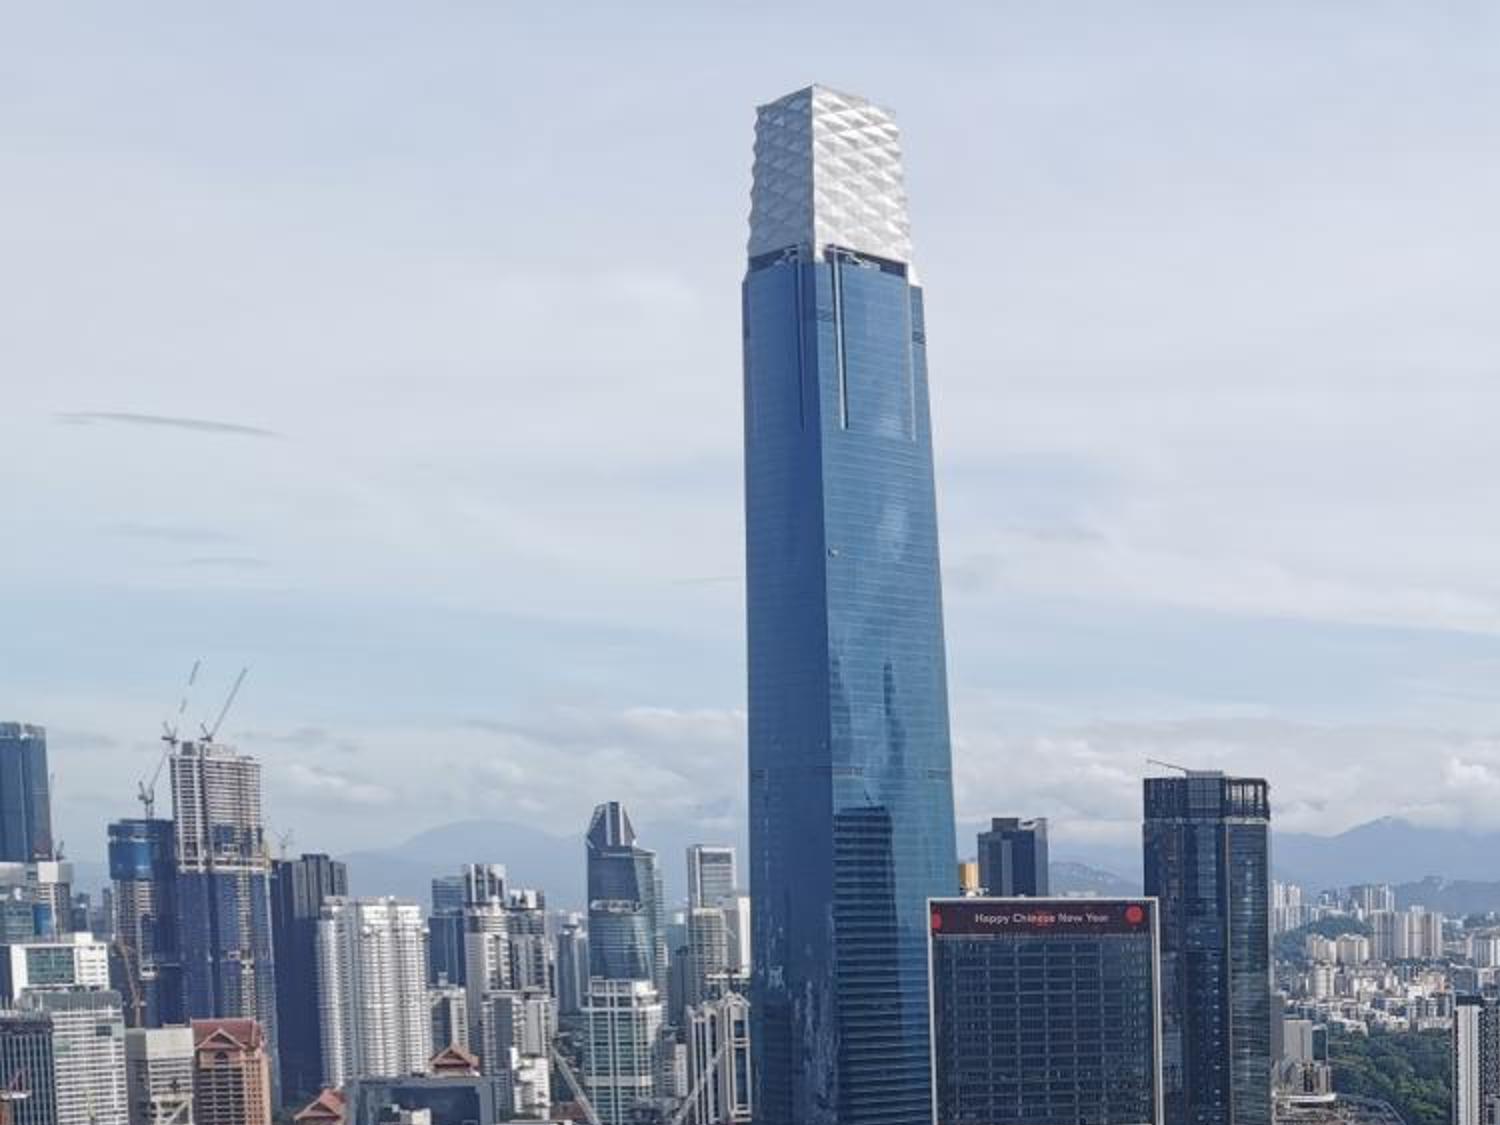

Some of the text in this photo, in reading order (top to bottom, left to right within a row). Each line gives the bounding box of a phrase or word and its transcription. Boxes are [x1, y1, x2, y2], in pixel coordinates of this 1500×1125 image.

[975, 912, 1108, 925] Happy Chinese New Year
